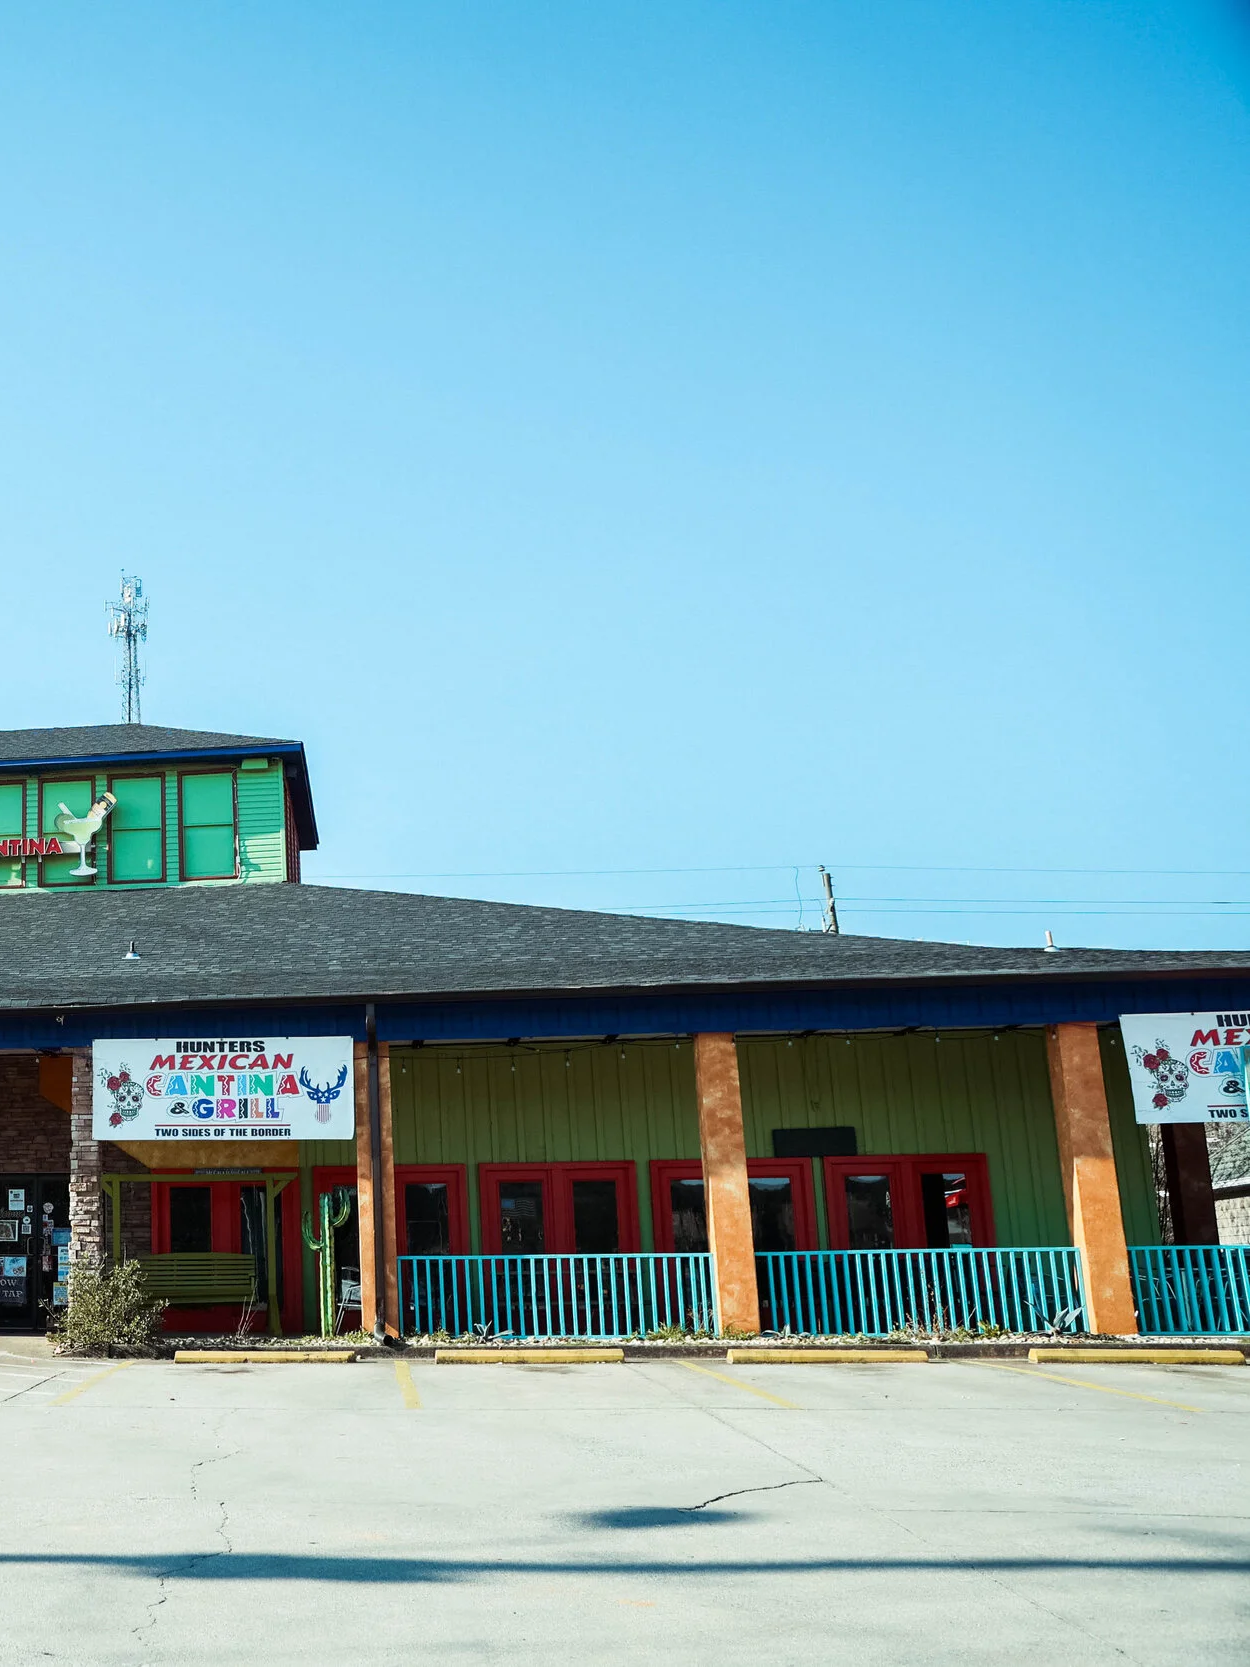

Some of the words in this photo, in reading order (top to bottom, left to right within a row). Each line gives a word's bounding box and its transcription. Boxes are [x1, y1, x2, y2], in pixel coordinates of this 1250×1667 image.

[176, 1040, 265, 1053] HUNTERS
[149, 1054, 294, 1071] MEXICAN
[146, 1075, 300, 1096] CANTINA
[169, 1102, 189, 1115] &
[192, 1098, 280, 1119] GRILL
[1208, 1109, 1237, 1118] TWO
[155, 1128, 179, 1137] TWO
[181, 1128, 211, 1137] SIDES
[213, 1128, 228, 1137] OF
[230, 1128, 248, 1137] THE
[251, 1127, 291, 1137] BORDER
